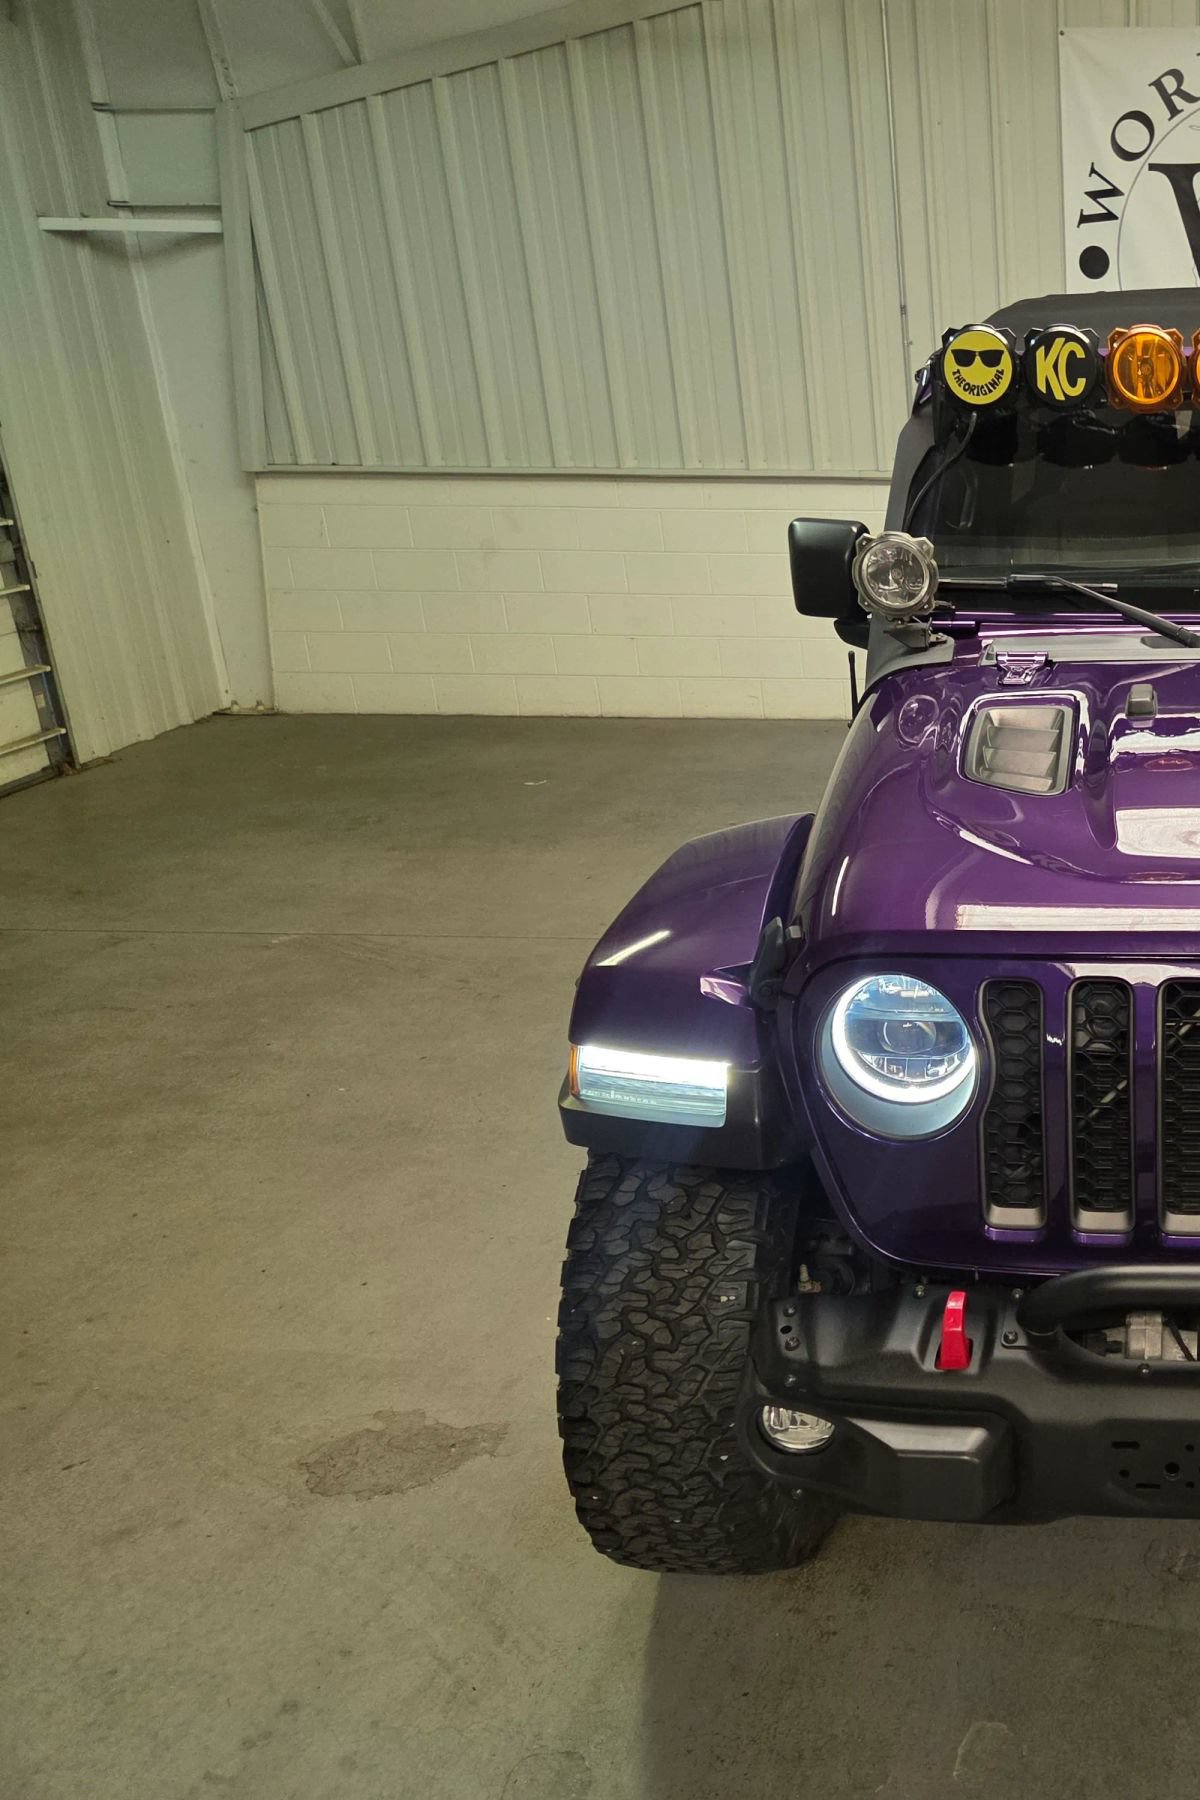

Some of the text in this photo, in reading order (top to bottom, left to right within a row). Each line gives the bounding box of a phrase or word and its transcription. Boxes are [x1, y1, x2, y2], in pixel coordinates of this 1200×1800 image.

[952, 368, 1005, 397] THE ORIGINAL
[1036, 337, 1086, 401] KC
